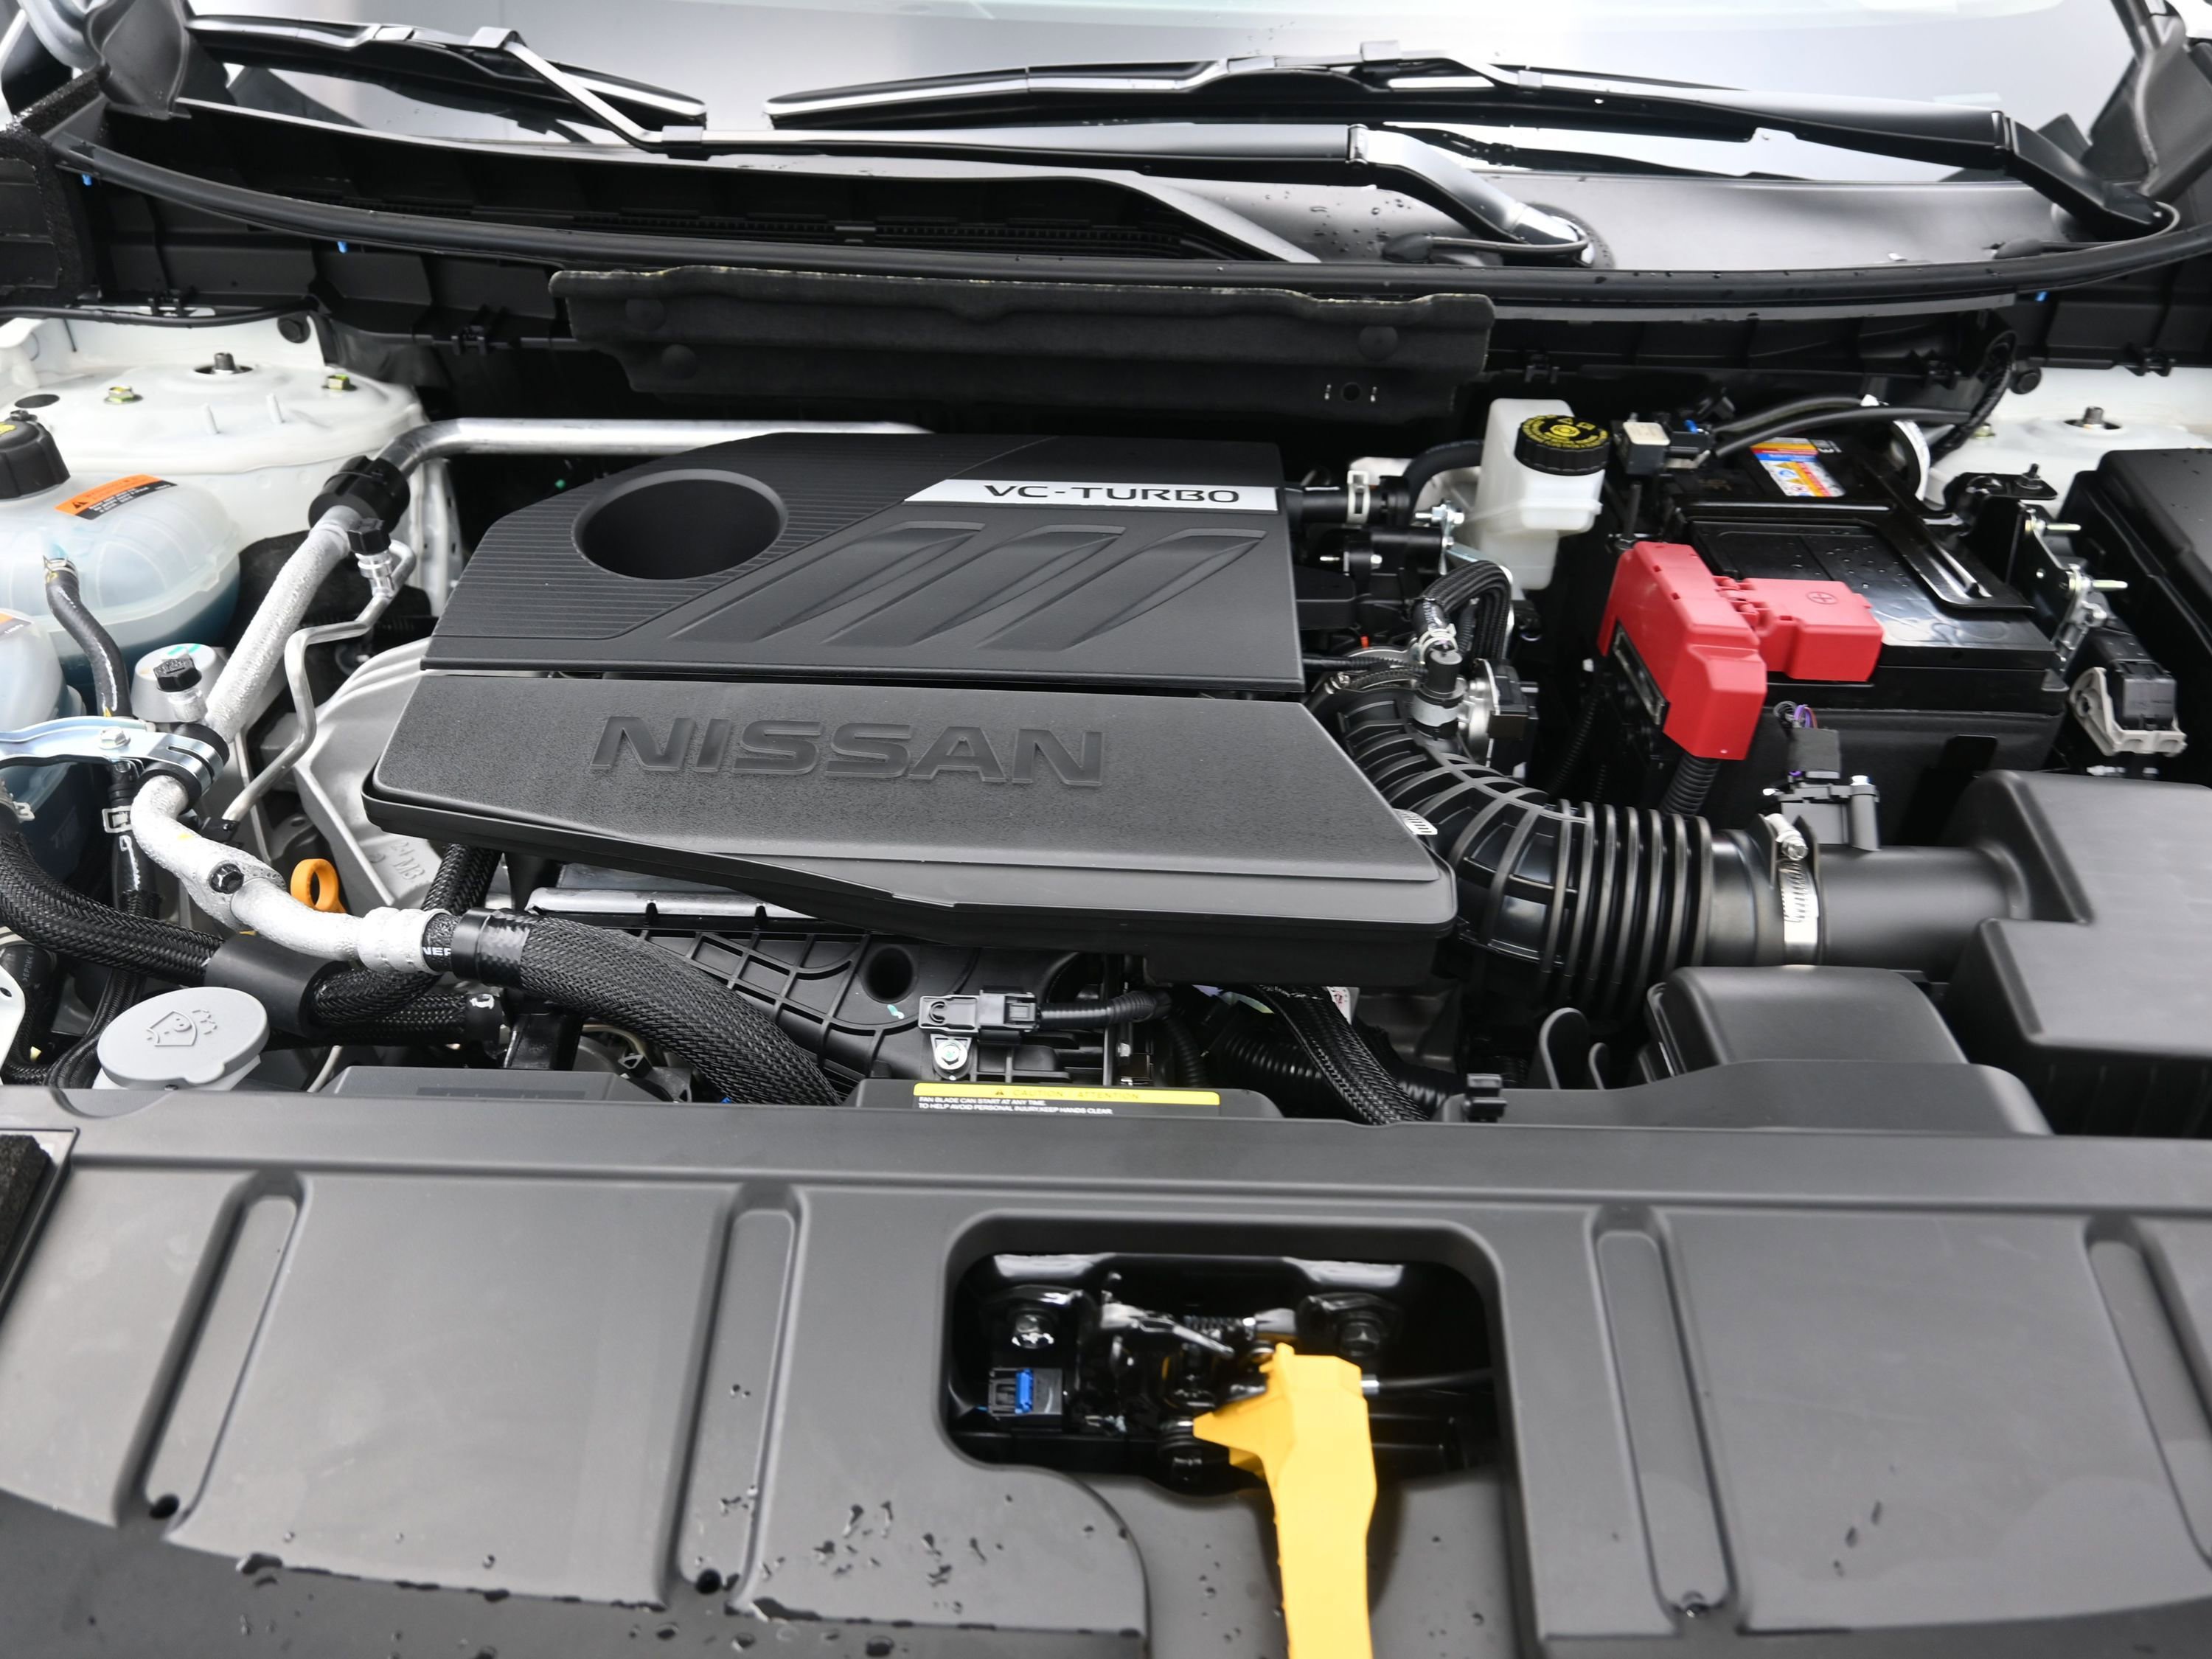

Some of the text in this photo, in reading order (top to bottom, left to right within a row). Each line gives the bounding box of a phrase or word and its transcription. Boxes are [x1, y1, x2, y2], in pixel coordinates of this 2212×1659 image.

[984, 484, 1240, 504] VC-TURBO
[589, 715, 1105, 787] NISSAN
[1012, 1089, 1063, 1097] CAUTION
[1077, 1091, 1139, 1099] ATTENTION
